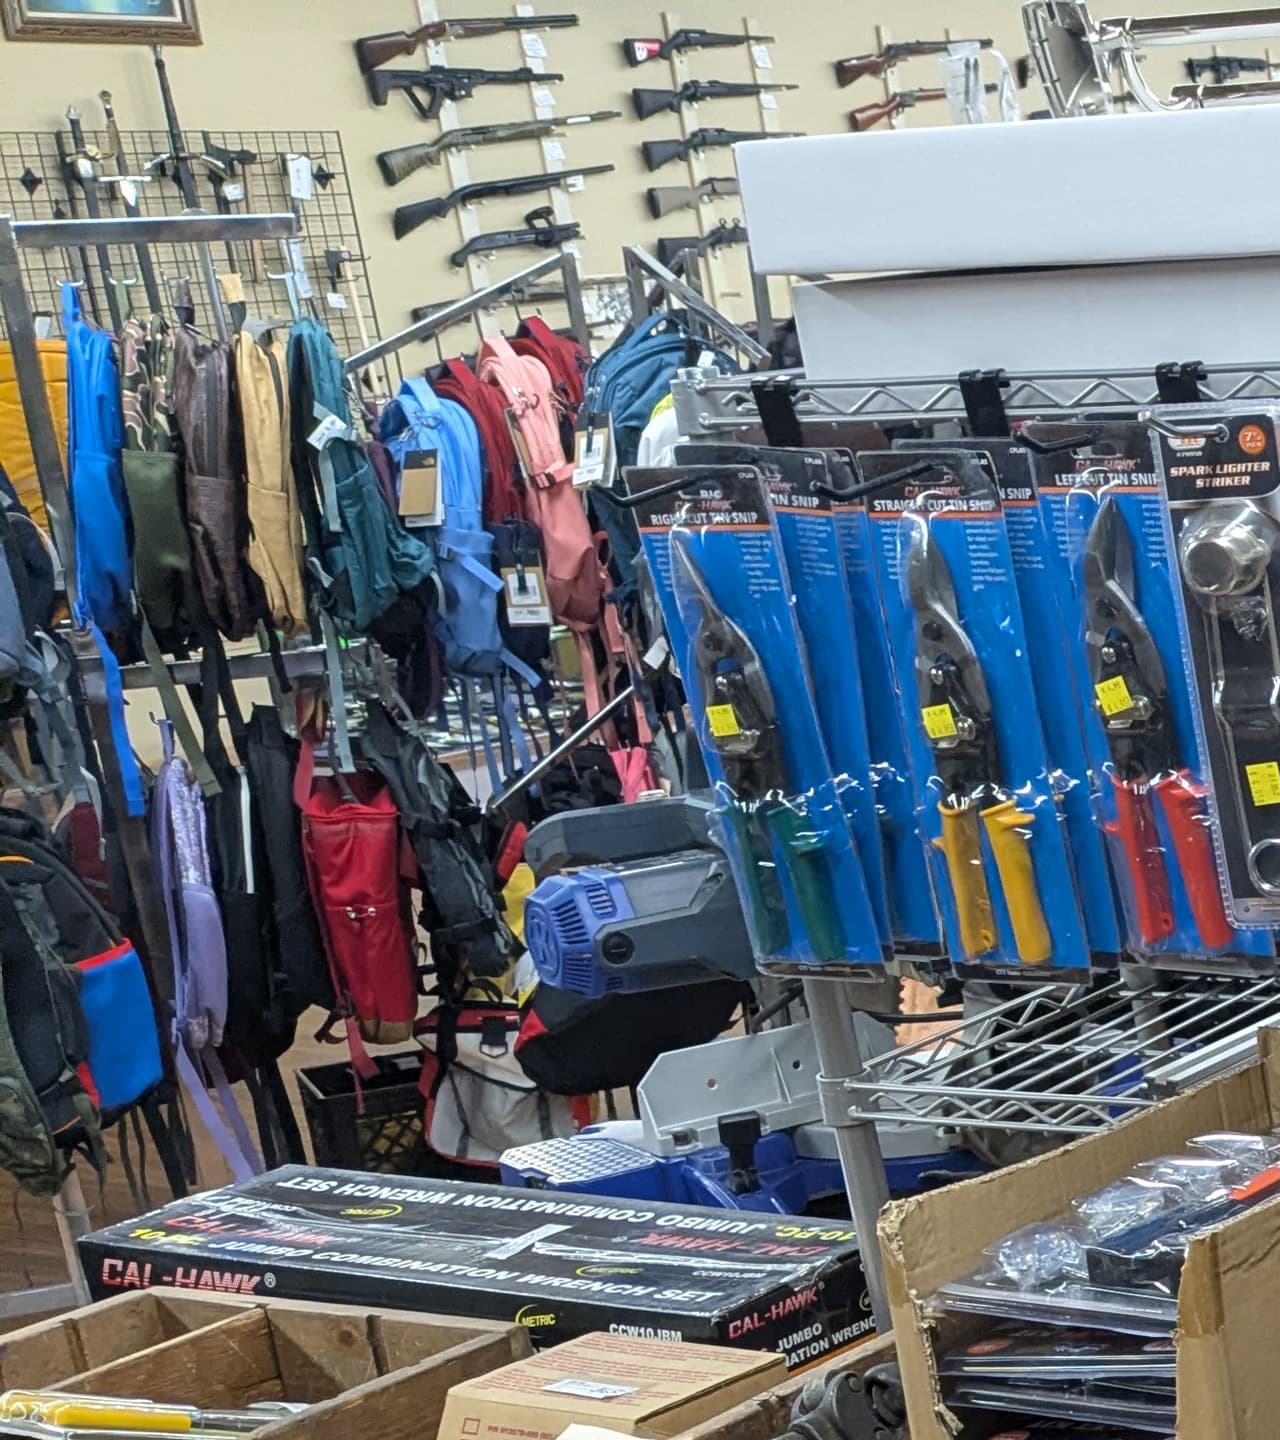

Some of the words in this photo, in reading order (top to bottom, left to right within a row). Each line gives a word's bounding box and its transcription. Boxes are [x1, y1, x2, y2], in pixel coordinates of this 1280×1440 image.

[1107, 472, 1127, 486] TIN
[1169, 463, 1212, 478] SPARK
[1213, 460, 1271, 475] LIGHTER
[1008, 486, 1033, 500] SNIP
[1195, 475, 1252, 489] STRIKER
[791, 495, 820, 508] SNIP
[276, 1176, 331, 1192] SET
[335, 1181, 450, 1205] WRENCH
[450, 1191, 656, 1223] COMBINATION
[163, 1214, 341, 1247] CAL-HAWK
[656, 1211, 768, 1236] JUMBO
[639, 1231, 832, 1257] CAL-HAWK
[208, 1239, 315, 1260] JUMBO
[311, 1250, 505, 1283] COMBINATION
[513, 1271, 654, 1299] WRENCH
[653, 1284, 726, 1302] SET
[521, 1311, 557, 1327] METRIC
[727, 1286, 819, 1340] CAL-HAWK
[608, 1322, 683, 1343] CCW10JBM
[775, 1322, 824, 1353] JUMBO
